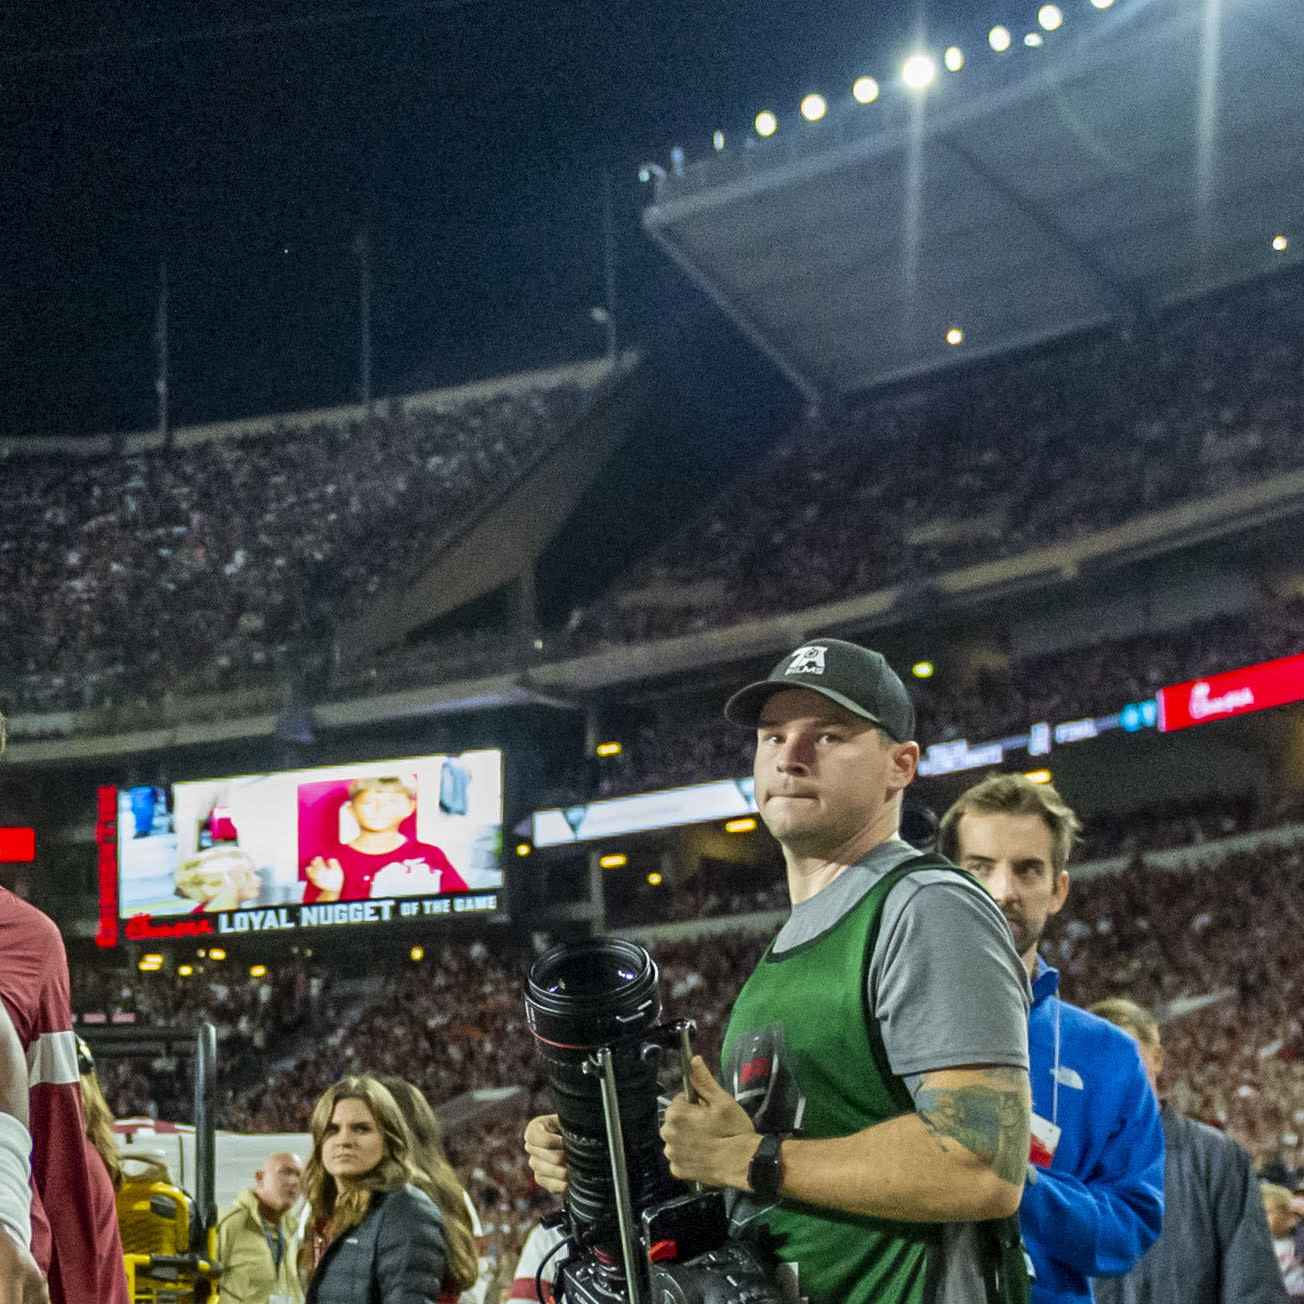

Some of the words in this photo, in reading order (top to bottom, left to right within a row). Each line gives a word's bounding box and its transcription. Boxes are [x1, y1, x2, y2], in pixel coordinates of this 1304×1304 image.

[219, 908, 294, 934] LOYAL
[300, 900, 395, 927] NUGGET
[401, 902, 421, 916] OF
[424, 899, 450, 914] THE
[455, 895, 497, 911] GAME
